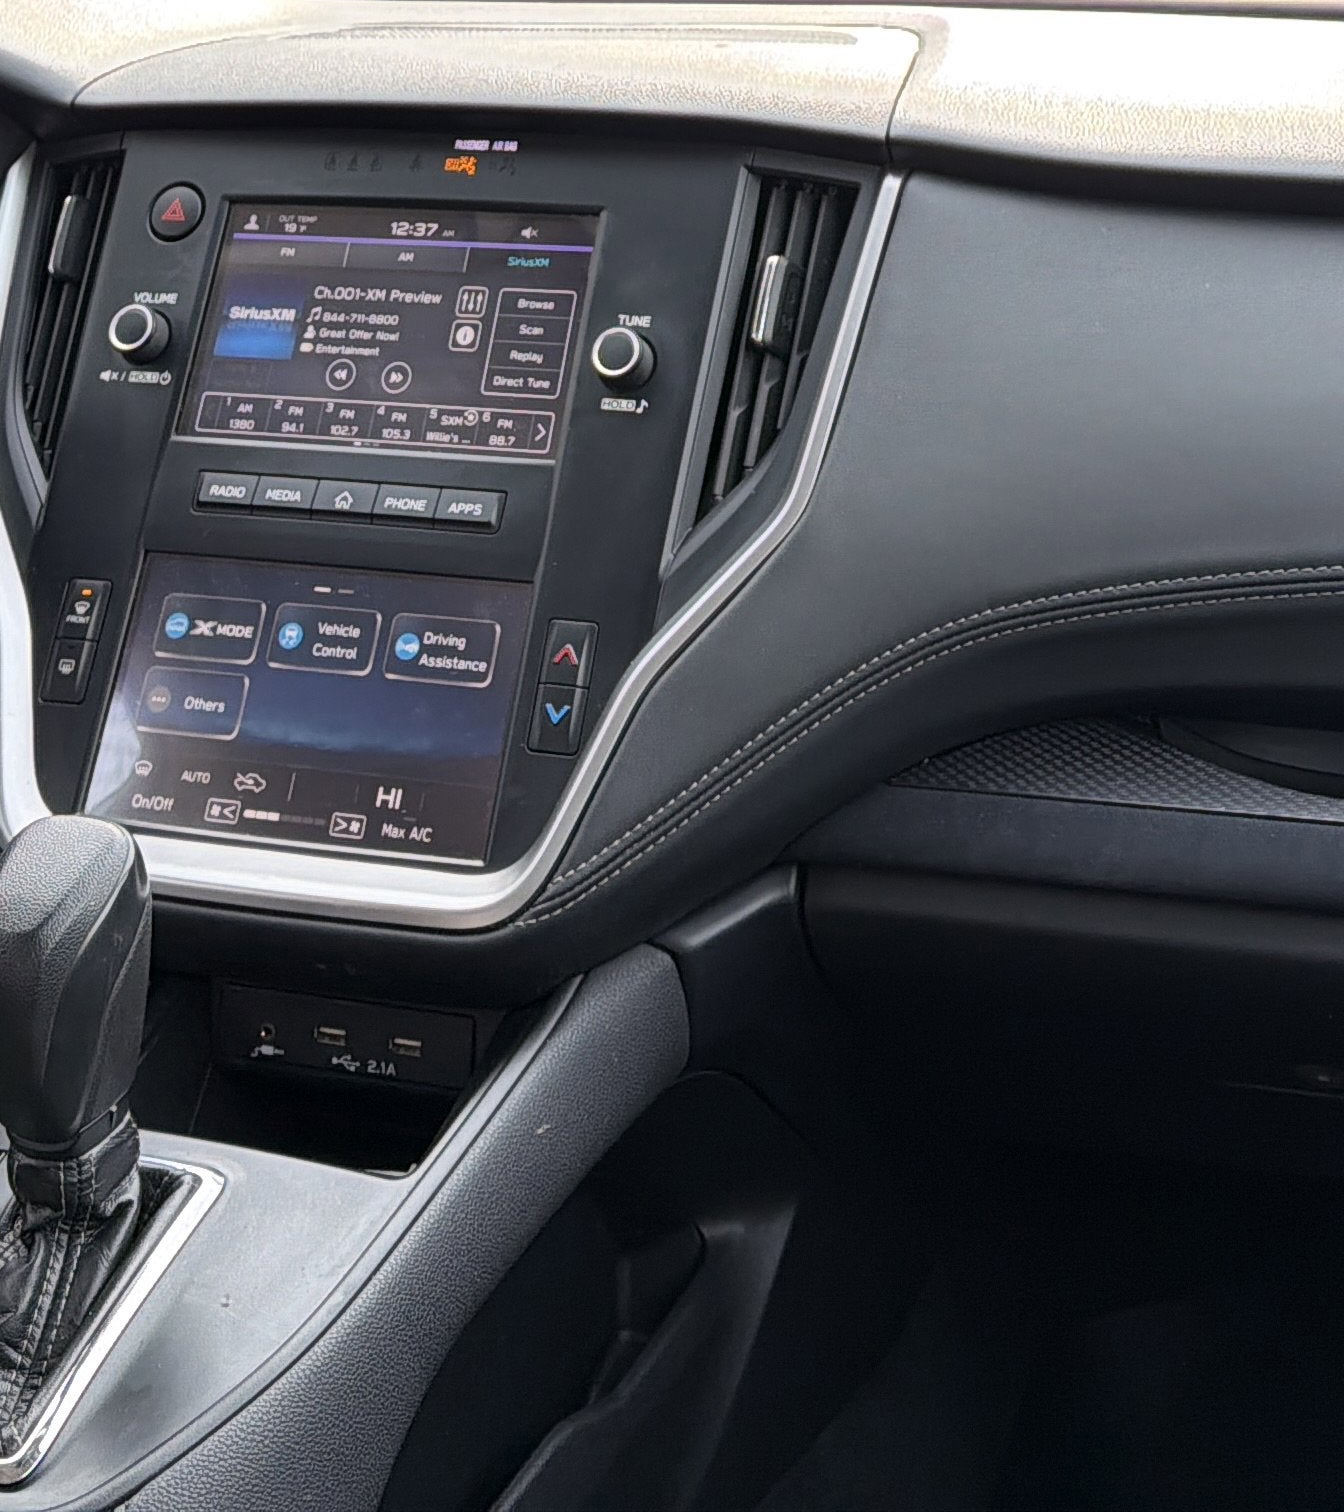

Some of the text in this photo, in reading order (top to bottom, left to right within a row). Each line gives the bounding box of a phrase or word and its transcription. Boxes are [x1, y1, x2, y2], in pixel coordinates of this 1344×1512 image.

[278, 214, 319, 224] OUT TEMP
[284, 222, 297, 233] 19
[389, 221, 455, 237] 12:37 AM
[280, 247, 296, 257] FM
[397, 252, 415, 262] AM
[507, 256, 550, 268] SiriusXM
[133, 291, 179, 305] VOLUME
[314, 285, 443, 305] Ch.001-XM Preview
[517, 298, 555, 310] Browse
[229, 305, 297, 322] SiriusXM
[617, 313, 652, 328] TUNE
[318, 327, 401, 342] Great Offer Now!
[518, 324, 545, 336] Scan
[314, 343, 380, 356] Entertainment
[509, 350, 544, 364] Replay
[492, 375, 551, 389] Direct Tune
[225, 397, 231, 406] 1
[274, 399, 283, 410] 2
[324, 402, 334, 413] 3
[602, 399, 636, 410] HOLD
[236, 403, 254, 413] AM
[288, 405, 304, 416] FM
[339, 408, 355, 419] FM
[376, 406, 386, 416] 4
[429, 408, 438, 419] 5
[391, 412, 407, 422] FM
[482, 412, 491, 422] 6
[229, 418, 255, 430] 1380
[280, 421, 305, 433] 94.1
[497, 419, 513, 430] FM
[330, 425, 359, 436] 102.7
[381, 428, 411, 439] 105.3
[425, 431, 459, 443] Willie's
[488, 435, 515, 446] 88.7
[209, 484, 247, 499] RADIO
[265, 488, 301, 502] MEDIA
[383, 496, 428, 512] PHONE
[447, 501, 483, 516] APPS
[65, 614, 91, 624] FRONT
[216, 624, 255, 639] MODE
[317, 621, 361, 639] Vehicle
[422, 631, 467, 651] Driving
[311, 642, 358, 660] Control
[418, 653, 488, 673] Assistance
[184, 695, 226, 713] Others
[180, 770, 212, 785] AUTO
[131, 793, 175, 812] On/Off
[374, 785, 404, 811] HI
[381, 823, 434, 844] Max A/C
[366, 1059, 397, 1076] 2.1A
